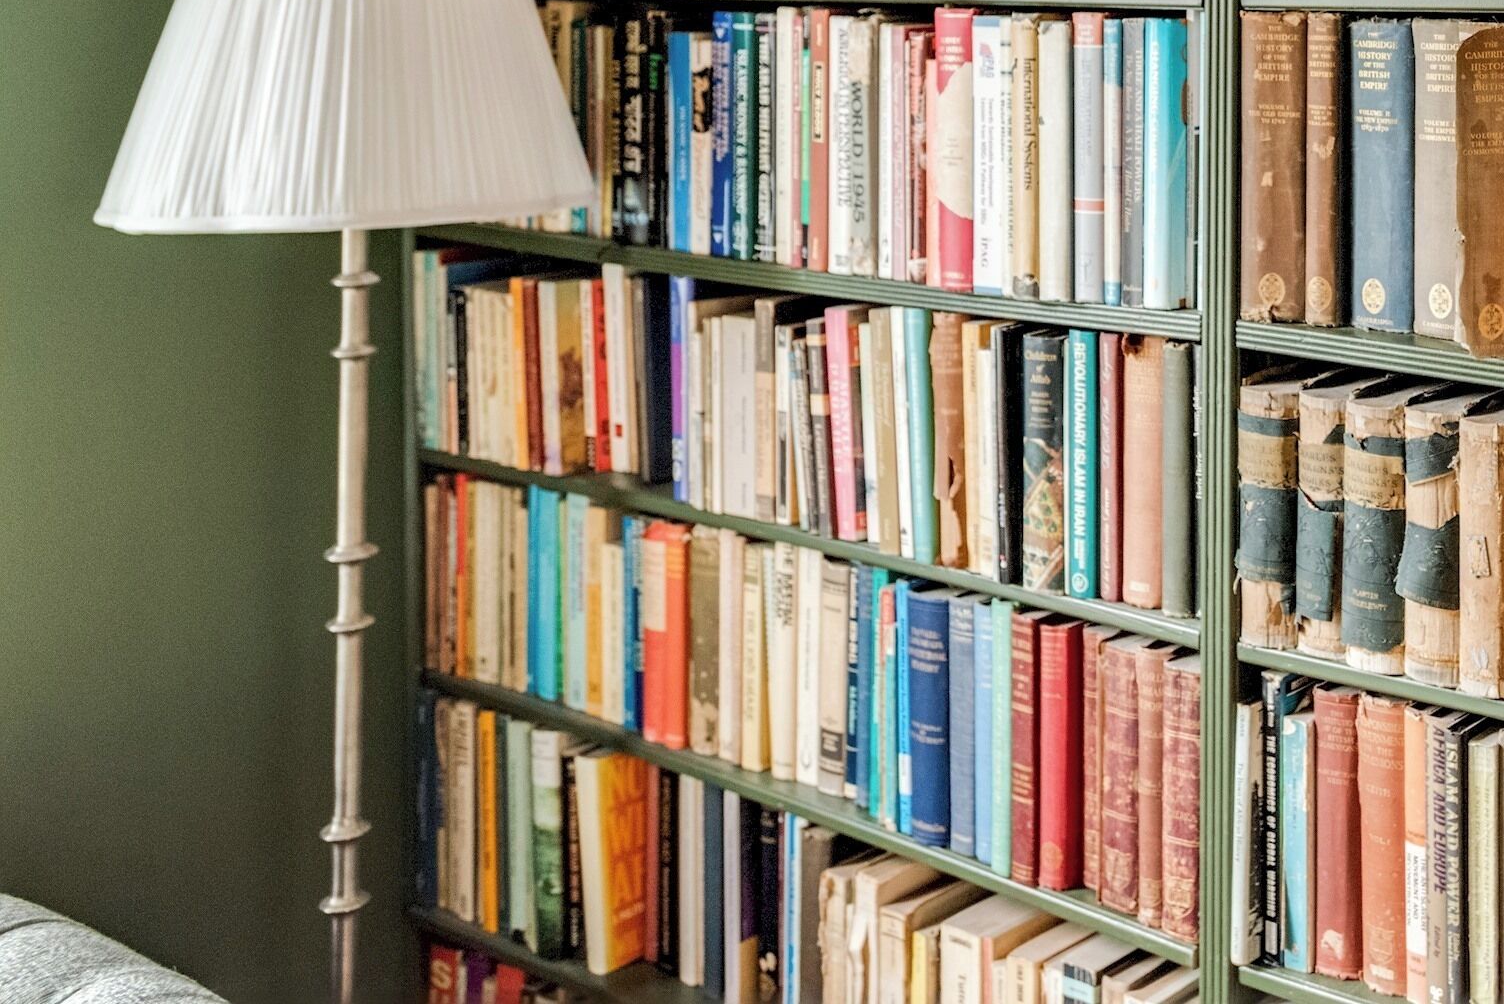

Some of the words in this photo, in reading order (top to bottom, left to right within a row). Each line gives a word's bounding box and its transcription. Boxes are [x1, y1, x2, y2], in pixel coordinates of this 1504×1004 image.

[1023, 57, 1037, 136] International
[1023, 140, 1038, 190] Systems
[1074, 344, 1087, 443] REVOLUTIONARY
[1075, 447, 1088, 487] ISLAM
[1074, 507, 1086, 538] IRAN
[1075, 492, 1087, 504] IN
[1433, 727, 1447, 785] AFRICA
[1433, 792, 1447, 826] AND
[1434, 830, 1448, 894] EUROPE
